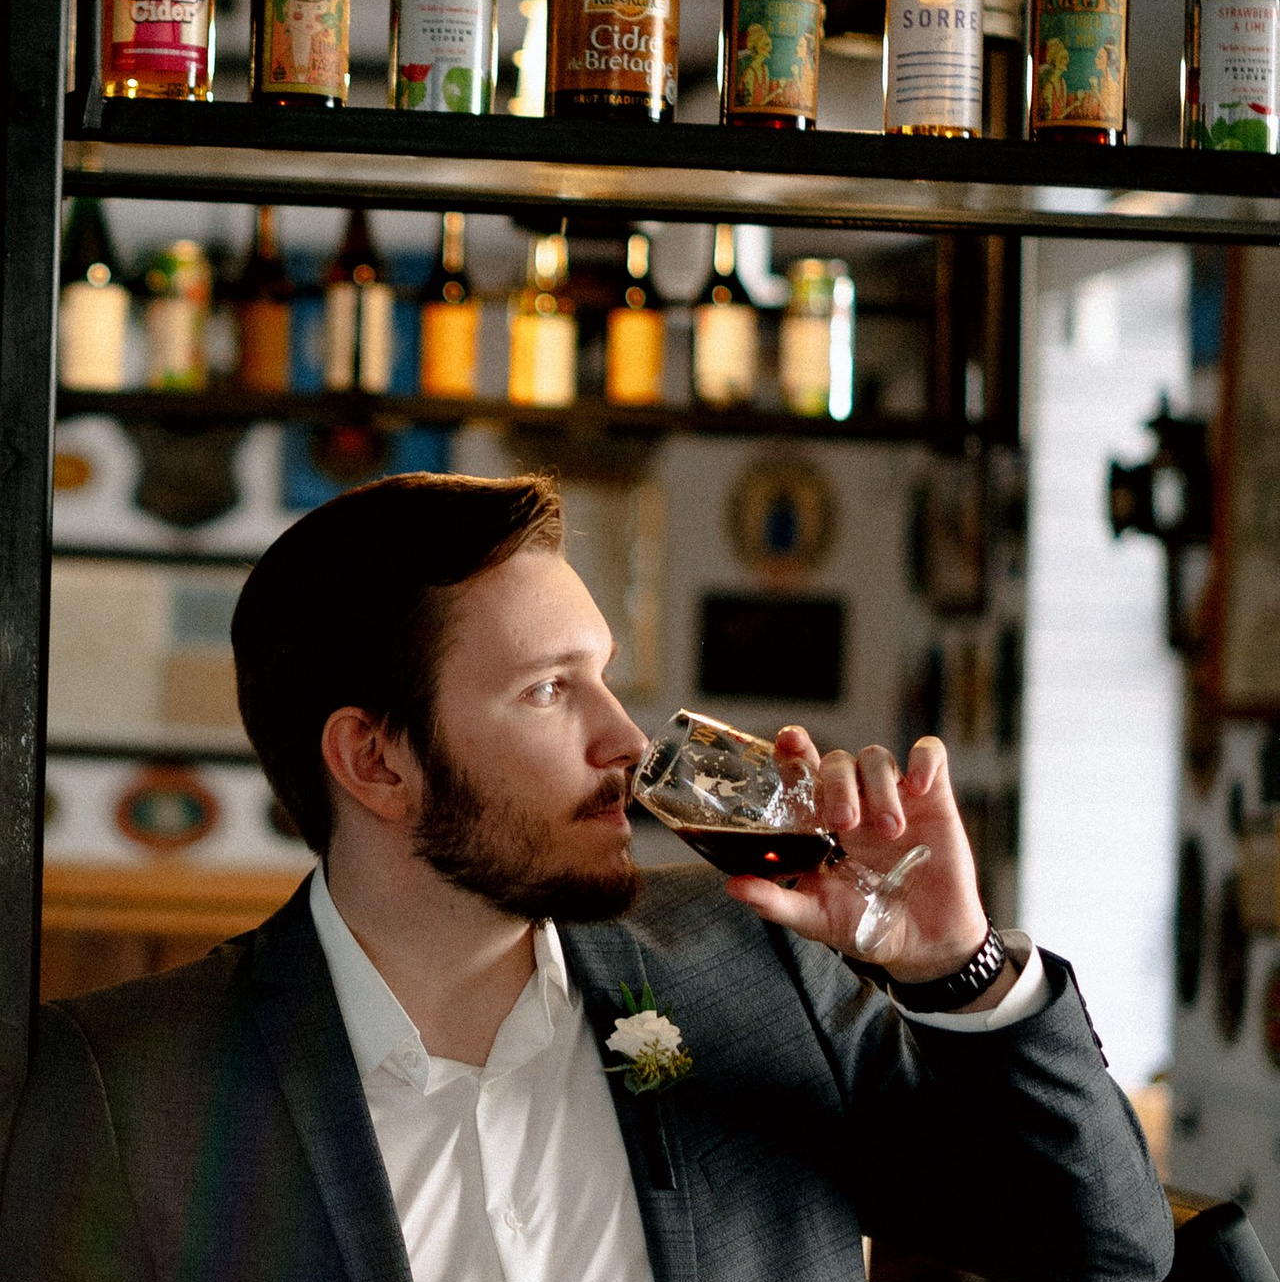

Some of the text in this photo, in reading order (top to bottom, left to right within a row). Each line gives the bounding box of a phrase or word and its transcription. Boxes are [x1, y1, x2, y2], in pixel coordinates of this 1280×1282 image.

[131, 0, 195, 22] Cider
[591, 24, 662, 53] Cidre
[584, 49, 674, 86] Bretage
